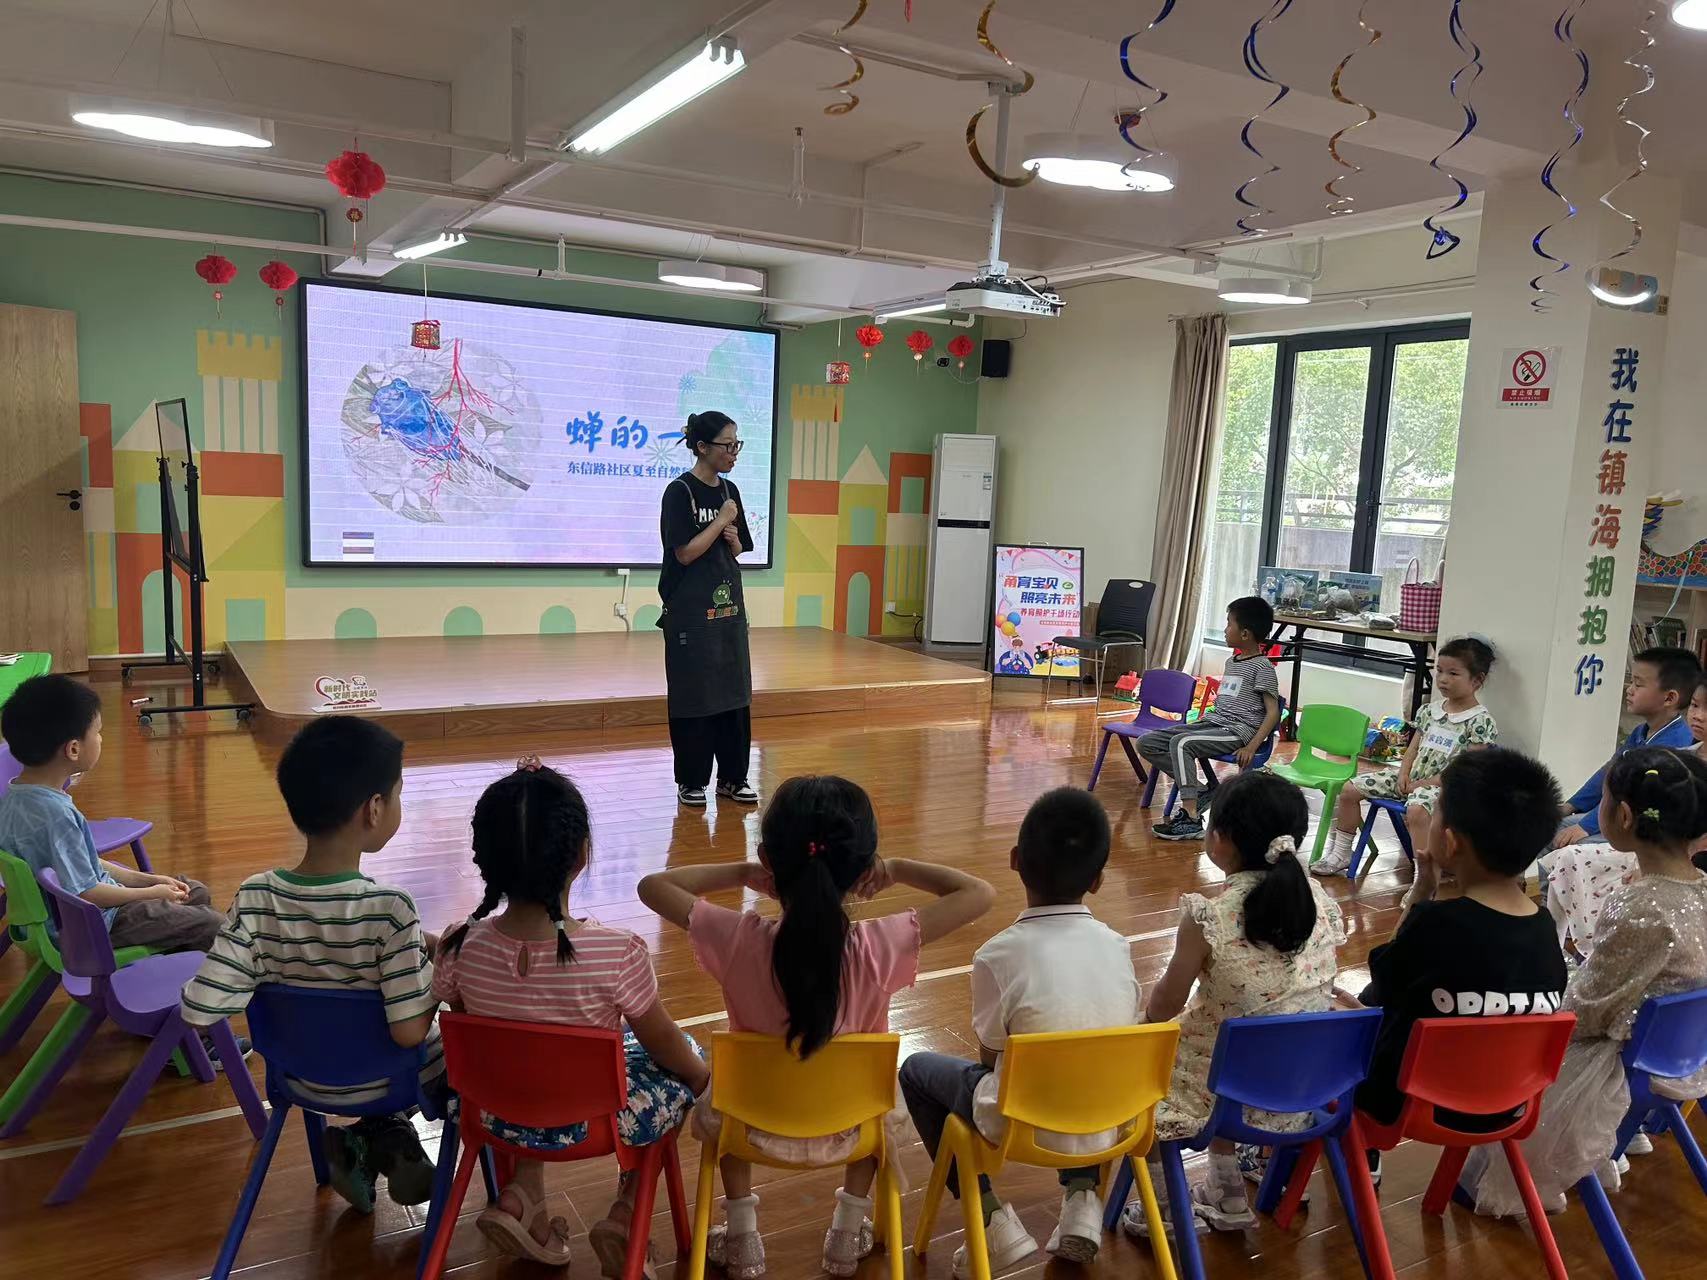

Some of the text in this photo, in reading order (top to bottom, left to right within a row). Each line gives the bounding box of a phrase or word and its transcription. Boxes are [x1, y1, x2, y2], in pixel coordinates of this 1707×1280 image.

[1020, 591, 1077, 605] 照亮未来
[1574, 347, 1640, 696] 我在镇海拥抱你
